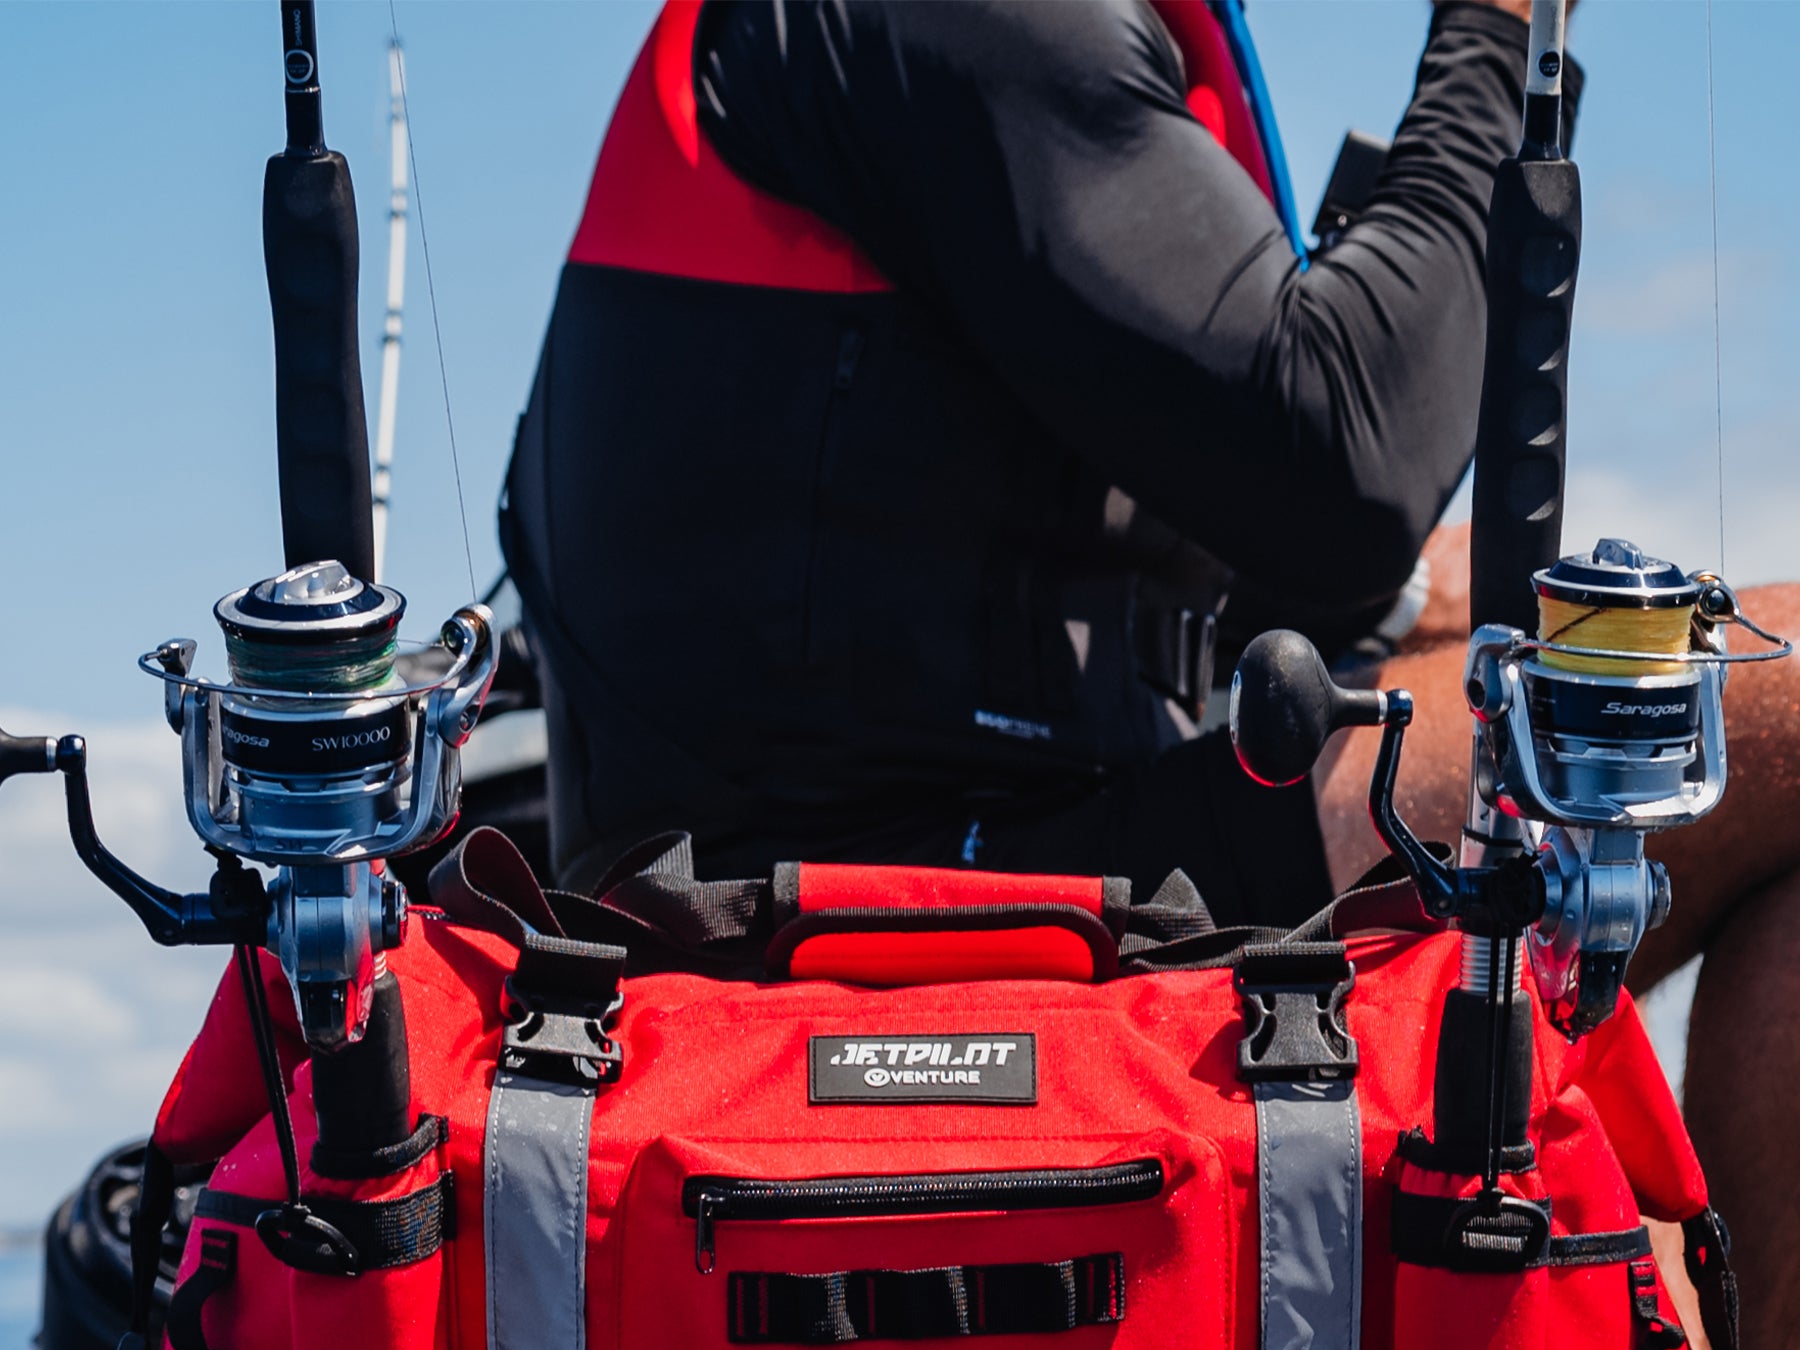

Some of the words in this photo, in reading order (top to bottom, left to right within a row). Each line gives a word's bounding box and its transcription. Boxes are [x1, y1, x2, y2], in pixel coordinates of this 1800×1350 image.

[1601, 702, 1687, 717] Saragosa
[830, 1043, 1016, 1065] JETPILOT
[891, 1070, 980, 1085] VENTURE
